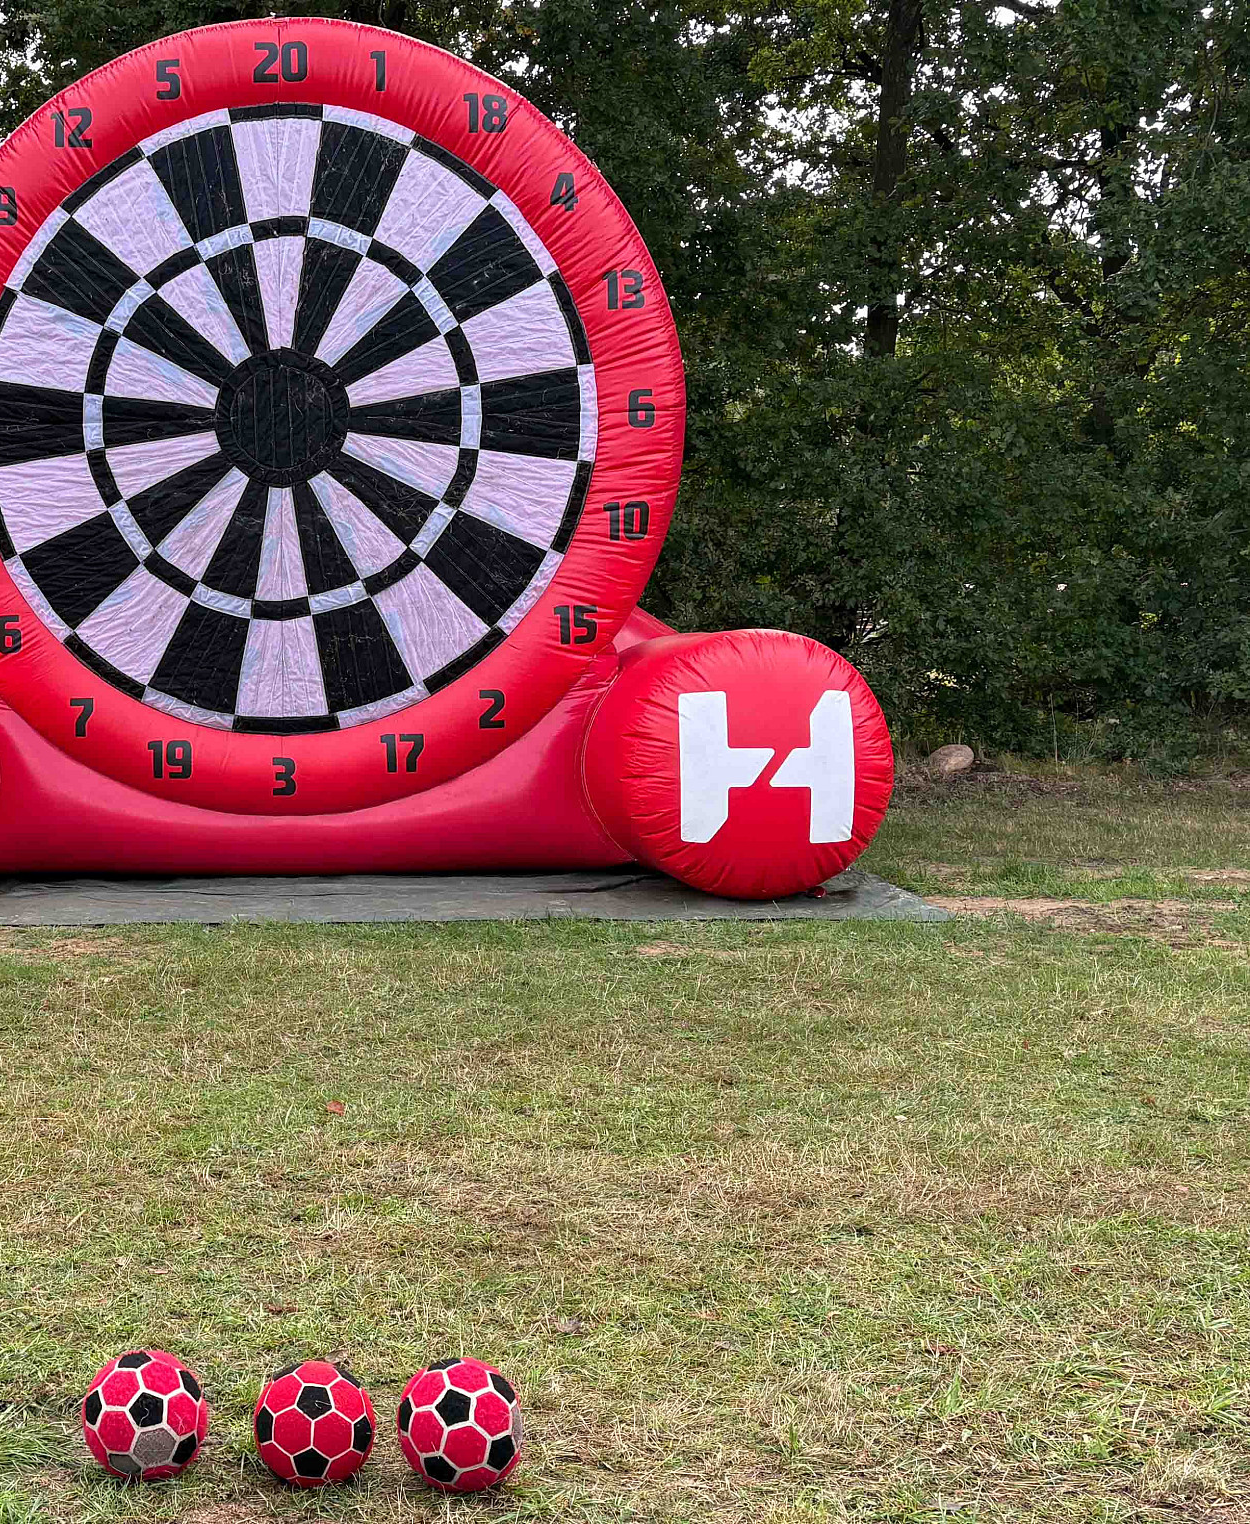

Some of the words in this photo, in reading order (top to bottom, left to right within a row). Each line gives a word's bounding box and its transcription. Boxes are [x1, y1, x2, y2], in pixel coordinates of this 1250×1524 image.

[157, 60, 180, 100] 5
[254, 42, 307, 83] 20
[371, 51, 385, 91] 1
[50, 108, 93, 148] 12
[464, 94, 508, 133] 18
[550, 173, 578, 211] 4
[602, 270, 644, 309] 13
[628, 389, 655, 427] 6
[604, 501, 649, 541] 10
[554, 606, 597, 644] 15
[70, 698, 93, 737] 7
[479, 690, 505, 728] 2
[148, 741, 191, 779] 19
[381, 734, 424, 772] 17
[678, 690, 855, 843] H
[273, 758, 296, 796] 3
